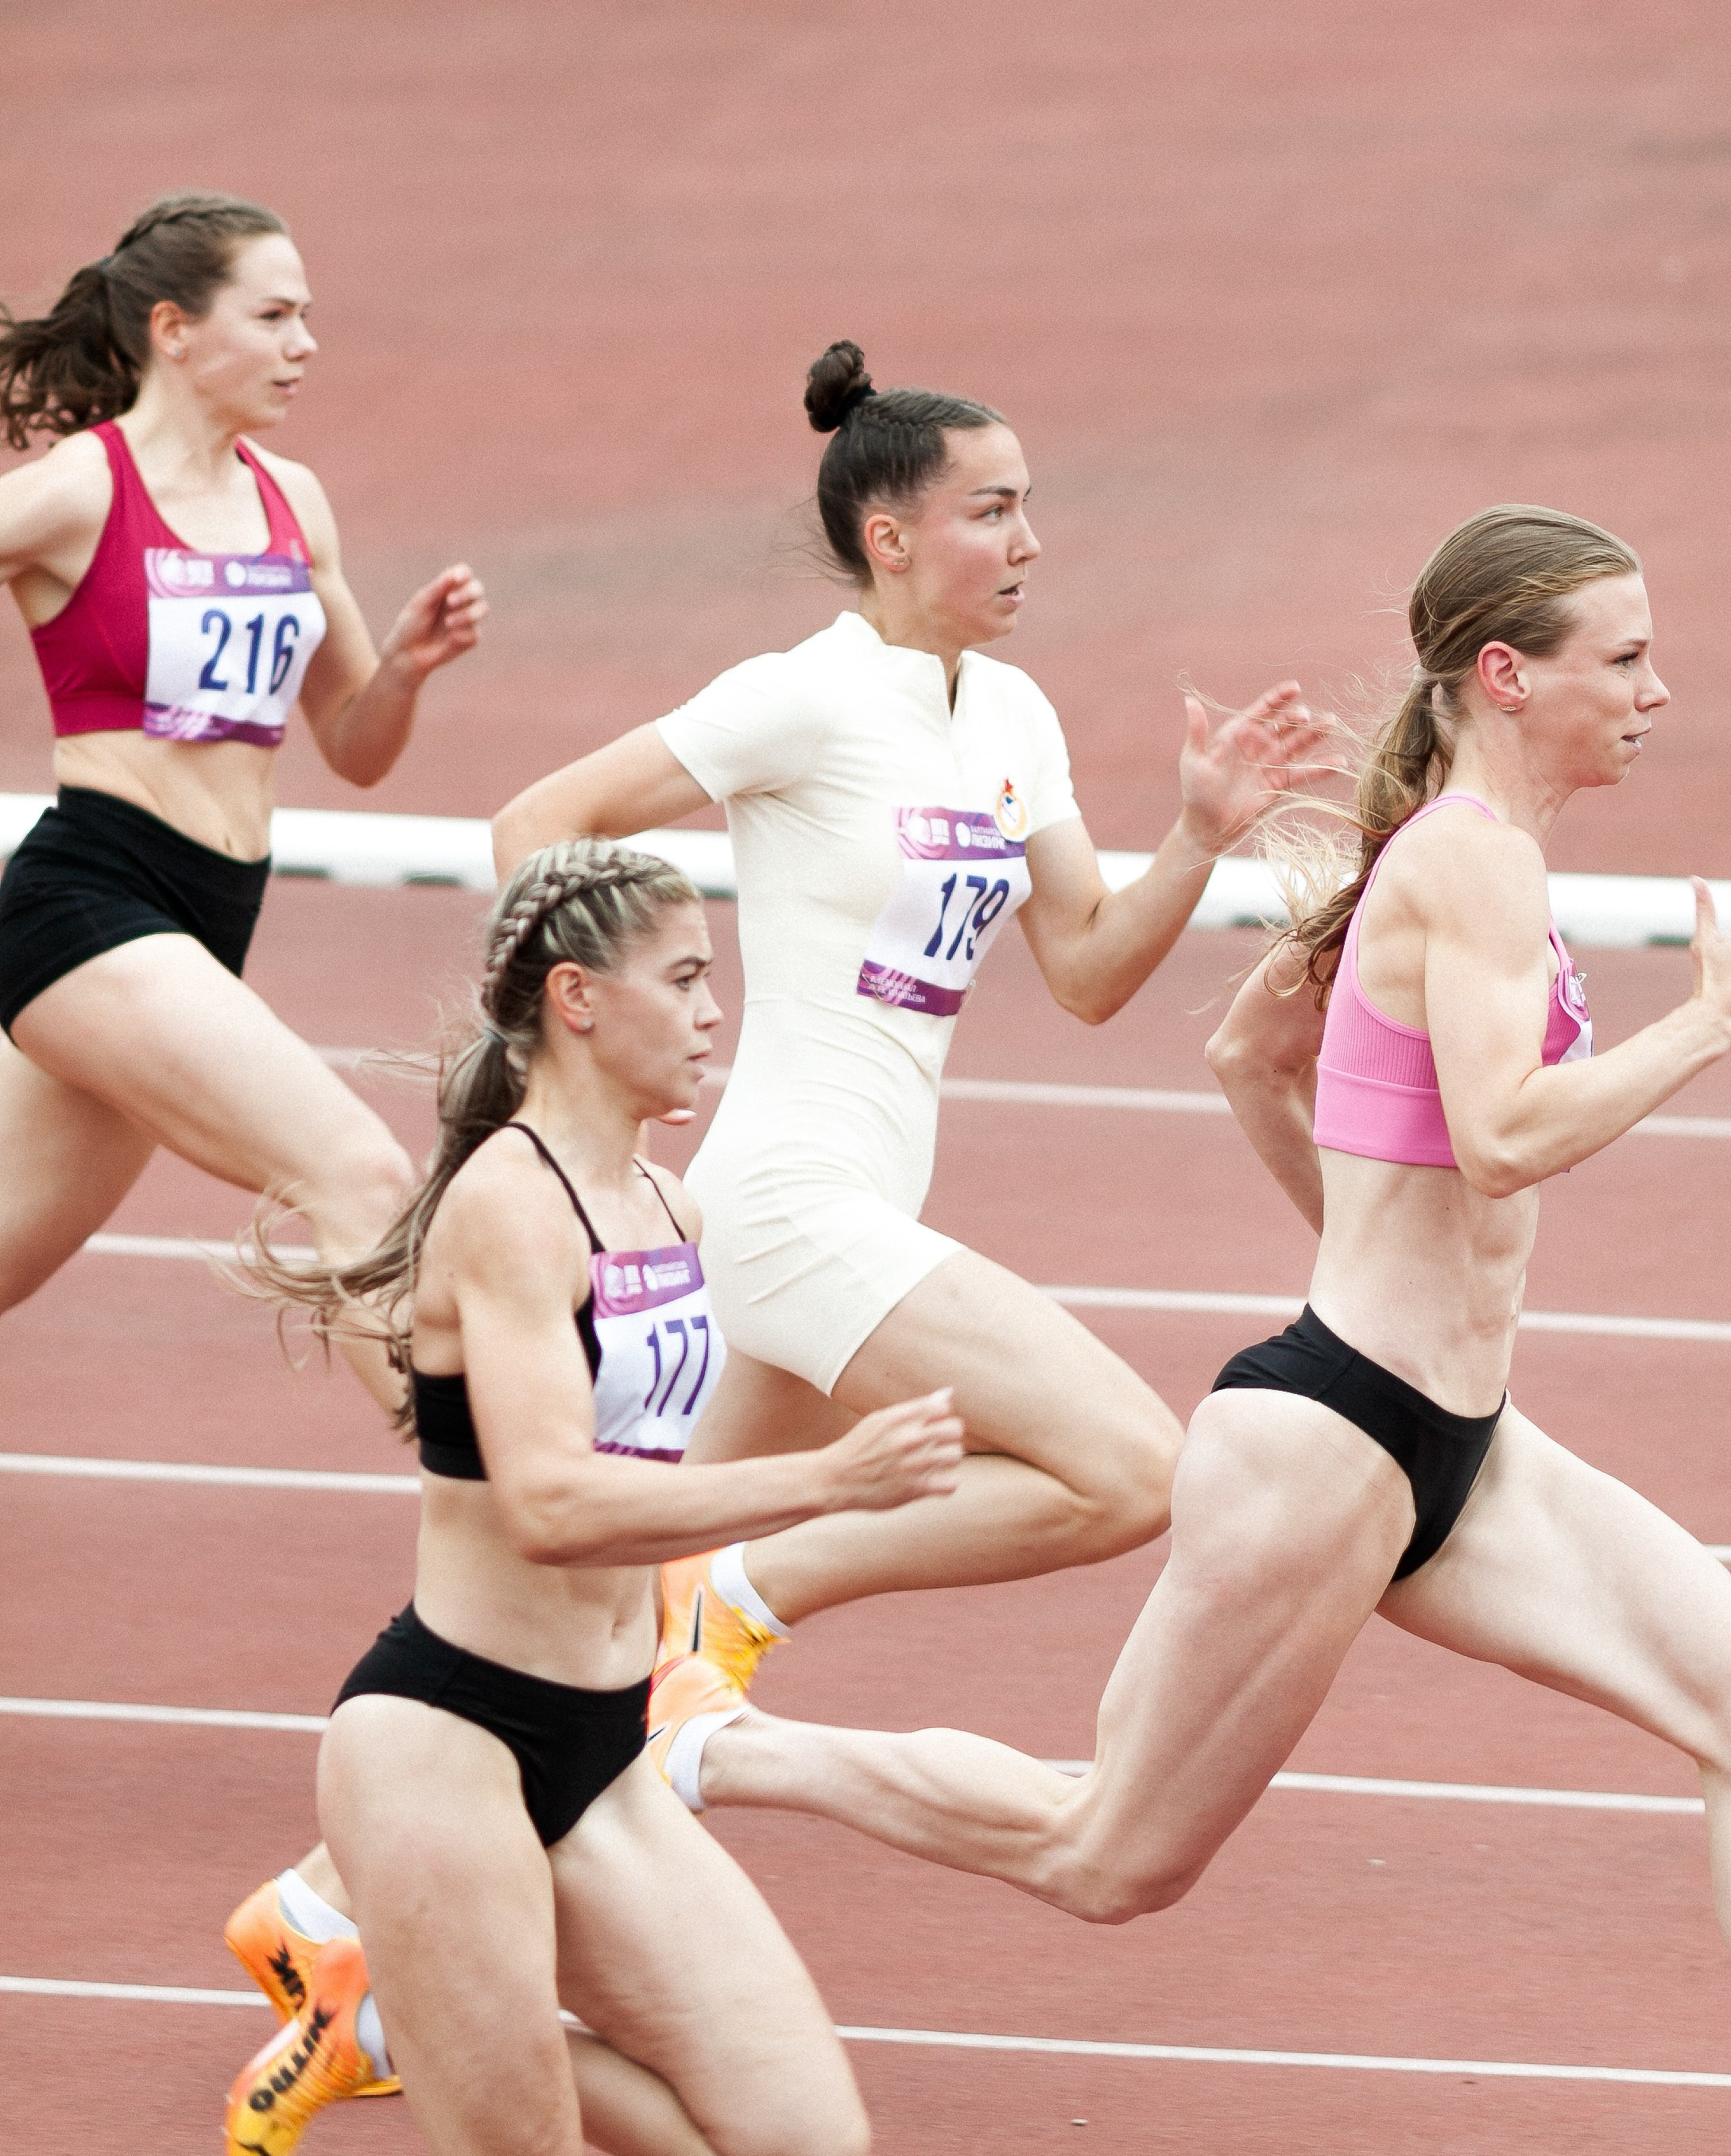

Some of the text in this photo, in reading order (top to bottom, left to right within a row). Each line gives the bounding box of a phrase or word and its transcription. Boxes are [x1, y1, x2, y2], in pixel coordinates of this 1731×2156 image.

[199, 608, 300, 695] 216
[924, 873, 1009, 961] 179
[645, 1315, 710, 1417] 177
